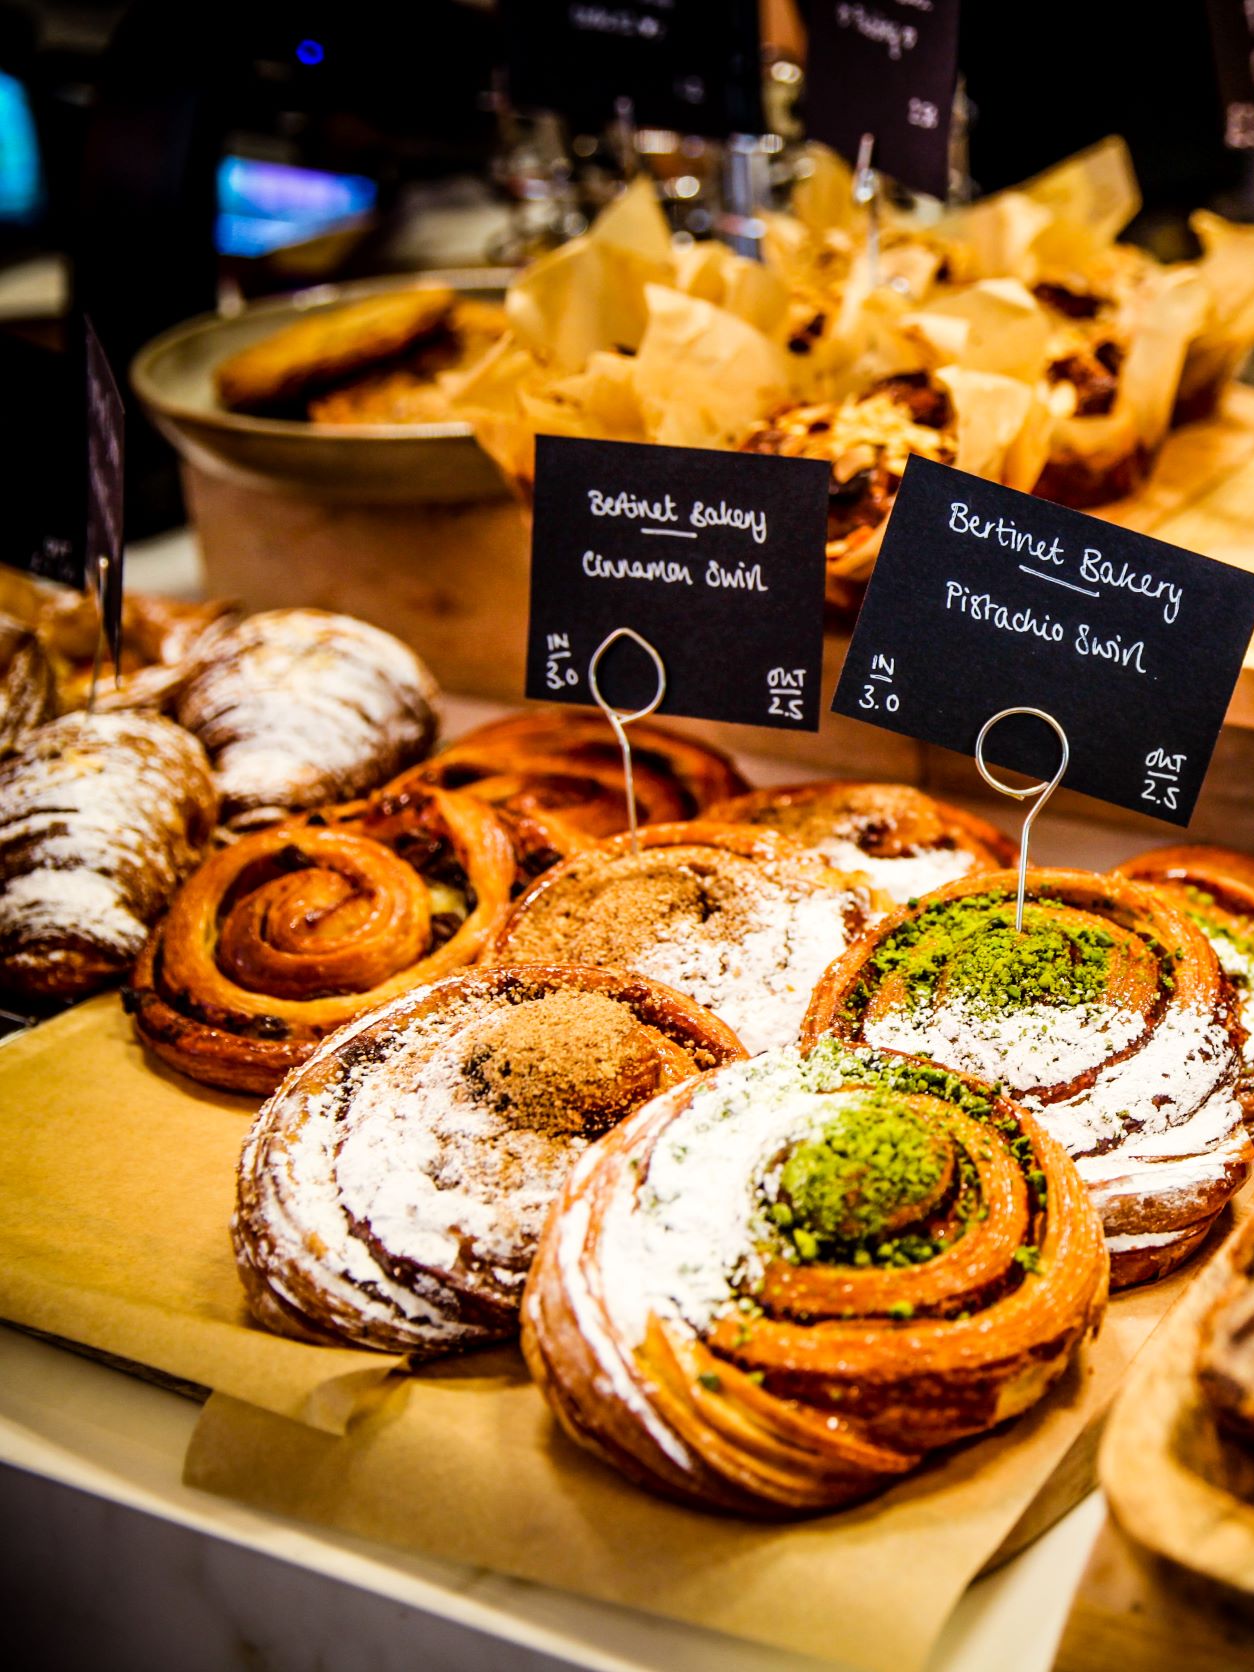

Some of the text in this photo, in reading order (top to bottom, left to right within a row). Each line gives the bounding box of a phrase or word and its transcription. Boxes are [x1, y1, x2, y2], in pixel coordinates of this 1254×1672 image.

[588, 490, 766, 543] Bertinet Bakery
[583, 551, 768, 591] Cinnamon Swirl
[949, 503, 1185, 624] Bertinet Bakery
[947, 580, 1146, 673] Pistachio Swirl
[547, 634, 569, 650] IN
[547, 660, 578, 689] 3.0
[767, 668, 806, 687] OUT
[870, 654, 894, 676] IN
[768, 697, 803, 720] 2.5
[859, 685, 899, 711] 3.0
[1145, 748, 1187, 774] OUT
[1141, 779, 1180, 809] 2.5
